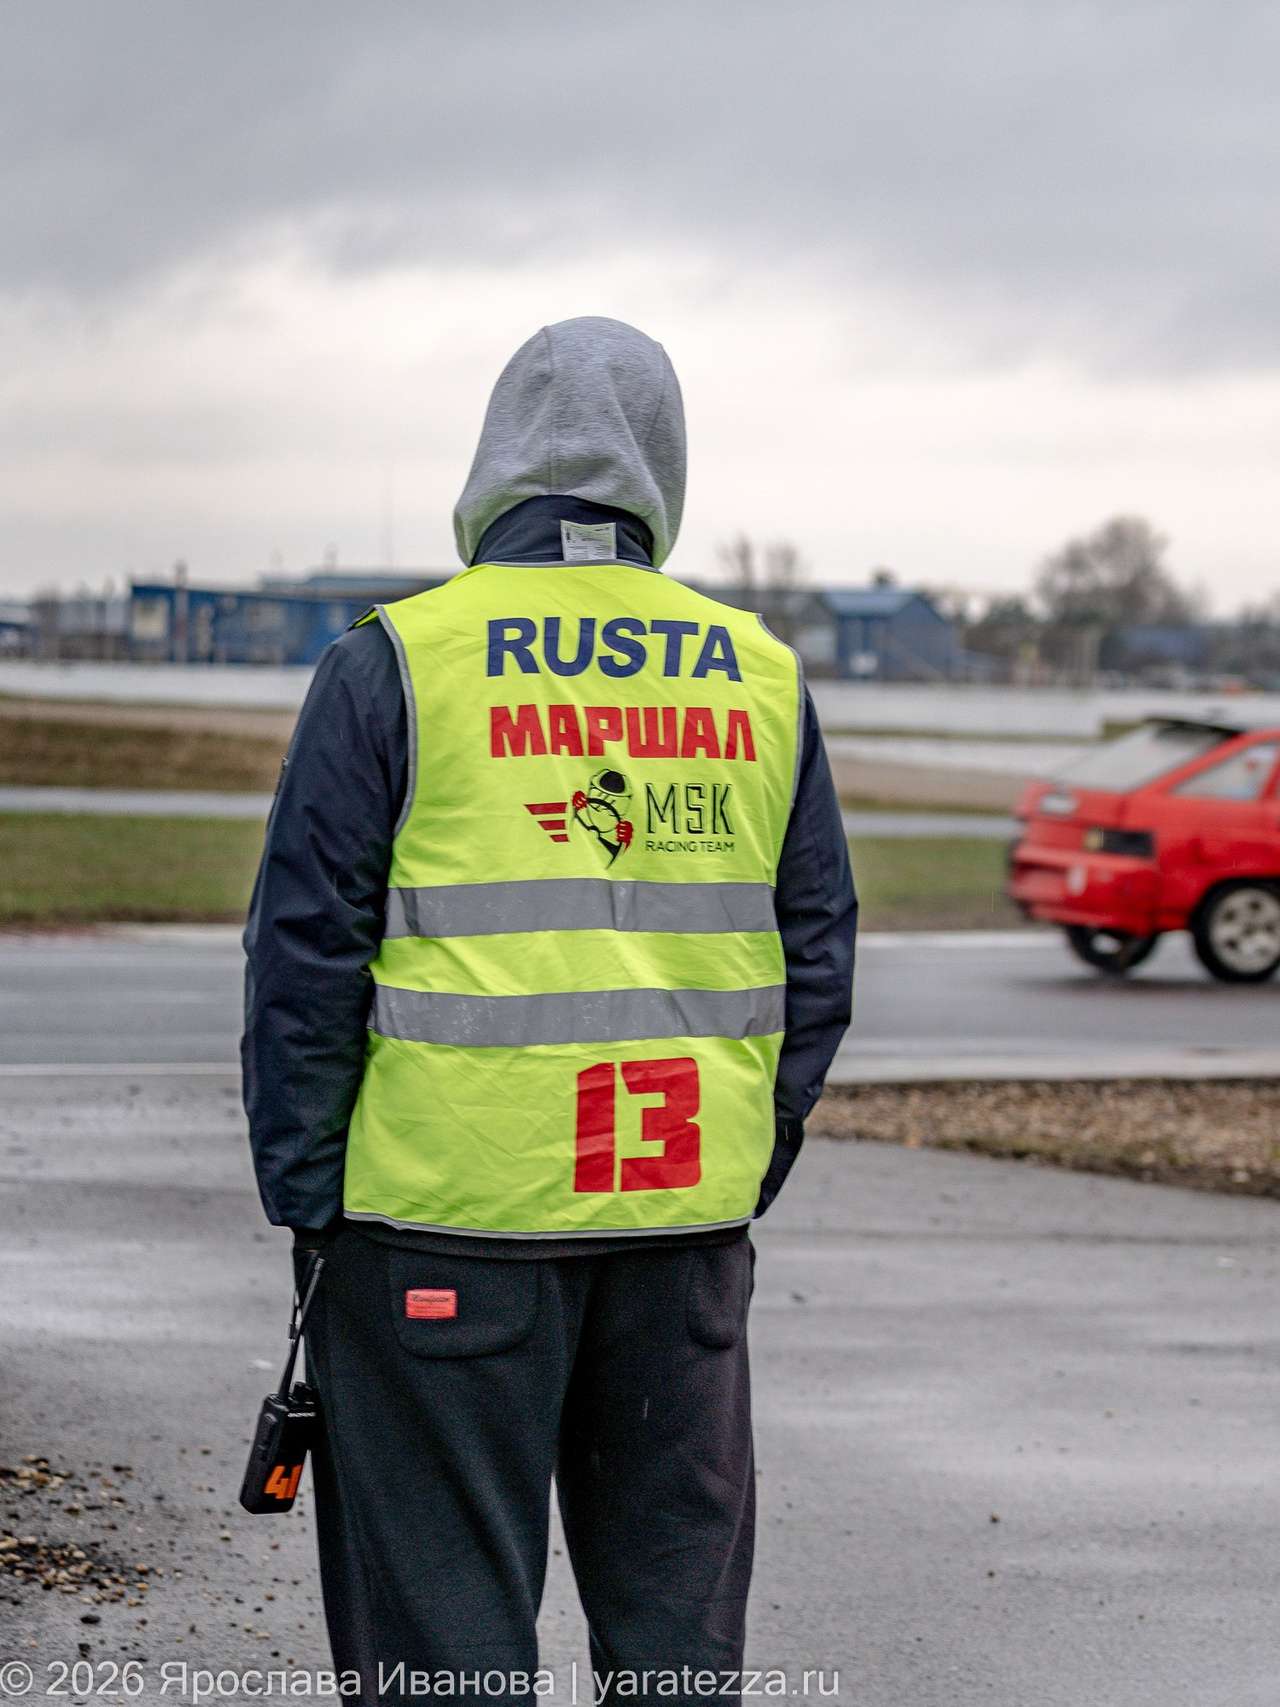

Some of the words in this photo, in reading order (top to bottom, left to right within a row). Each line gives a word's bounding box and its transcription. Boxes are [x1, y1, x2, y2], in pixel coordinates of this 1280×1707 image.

[487, 617, 743, 682] RUSTA
[490, 704, 756, 761] МАРШАЛ
[645, 783, 735, 834] MSK
[645, 840, 697, 852] RACING
[700, 841, 735, 852] TEAM
[574, 1057, 701, 1192] 13
